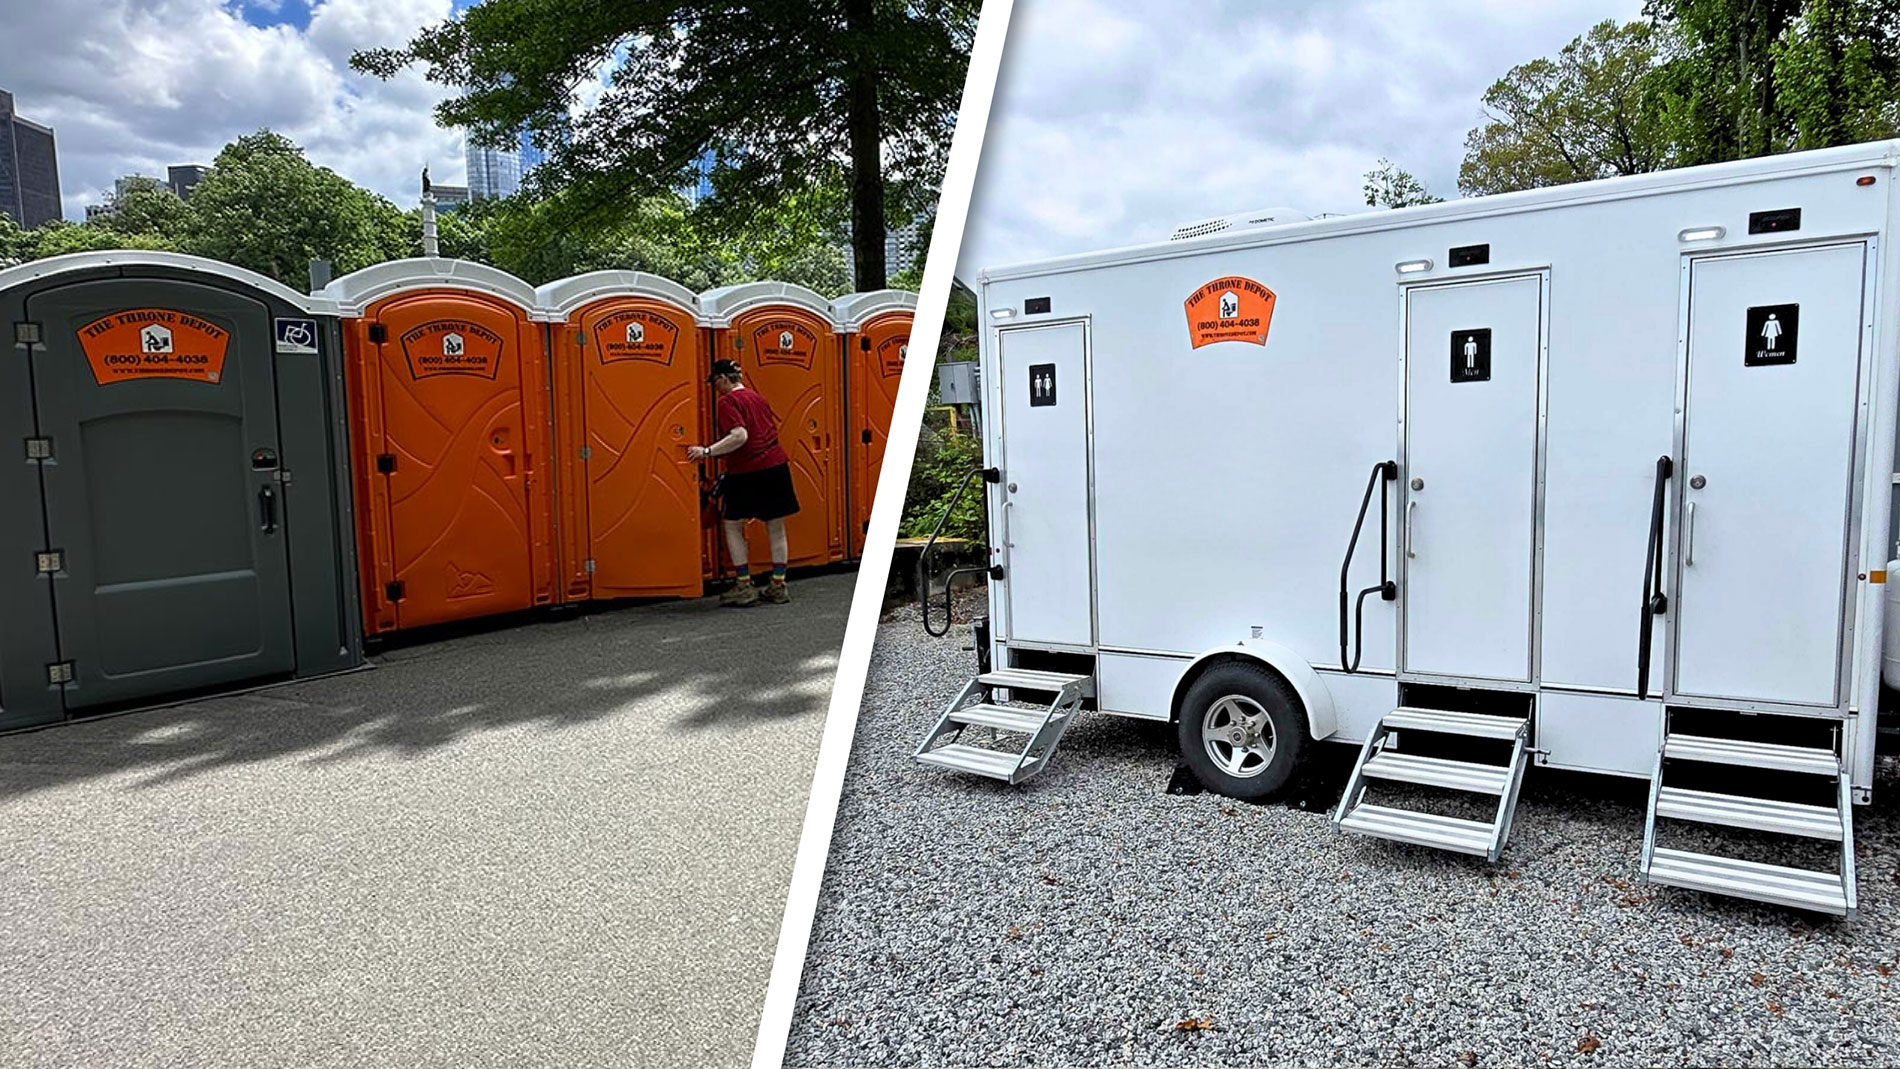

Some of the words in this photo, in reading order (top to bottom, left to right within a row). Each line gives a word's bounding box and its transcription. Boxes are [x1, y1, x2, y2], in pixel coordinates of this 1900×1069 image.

[1188, 290, 1205, 308] THE
[1206, 279, 1242, 294] THRONE
[1244, 281, 1272, 302] DEPOT
[84, 319, 114, 339] THE
[116, 311, 175, 325] THRONE
[180, 313, 224, 339] DEPOT
[597, 320, 611, 332] THE
[613, 313, 647, 323] THRONE
[648, 315, 674, 332] DEPOT
[1197, 321, 1218, 331] (800)
[1220, 319, 1259, 328] 404-4038
[407, 329, 425, 343] THE
[428, 323, 466, 333] THRONE
[469, 324, 497, 344] DEPOT
[606, 343, 626, 351] (800)
[104, 354, 141, 366] (800)
[144, 355, 208, 364] 404-4038
[1756, 350, 1785, 358] Women
[418, 356, 443, 365] (800)
[445, 356, 488, 364] 404-4038
